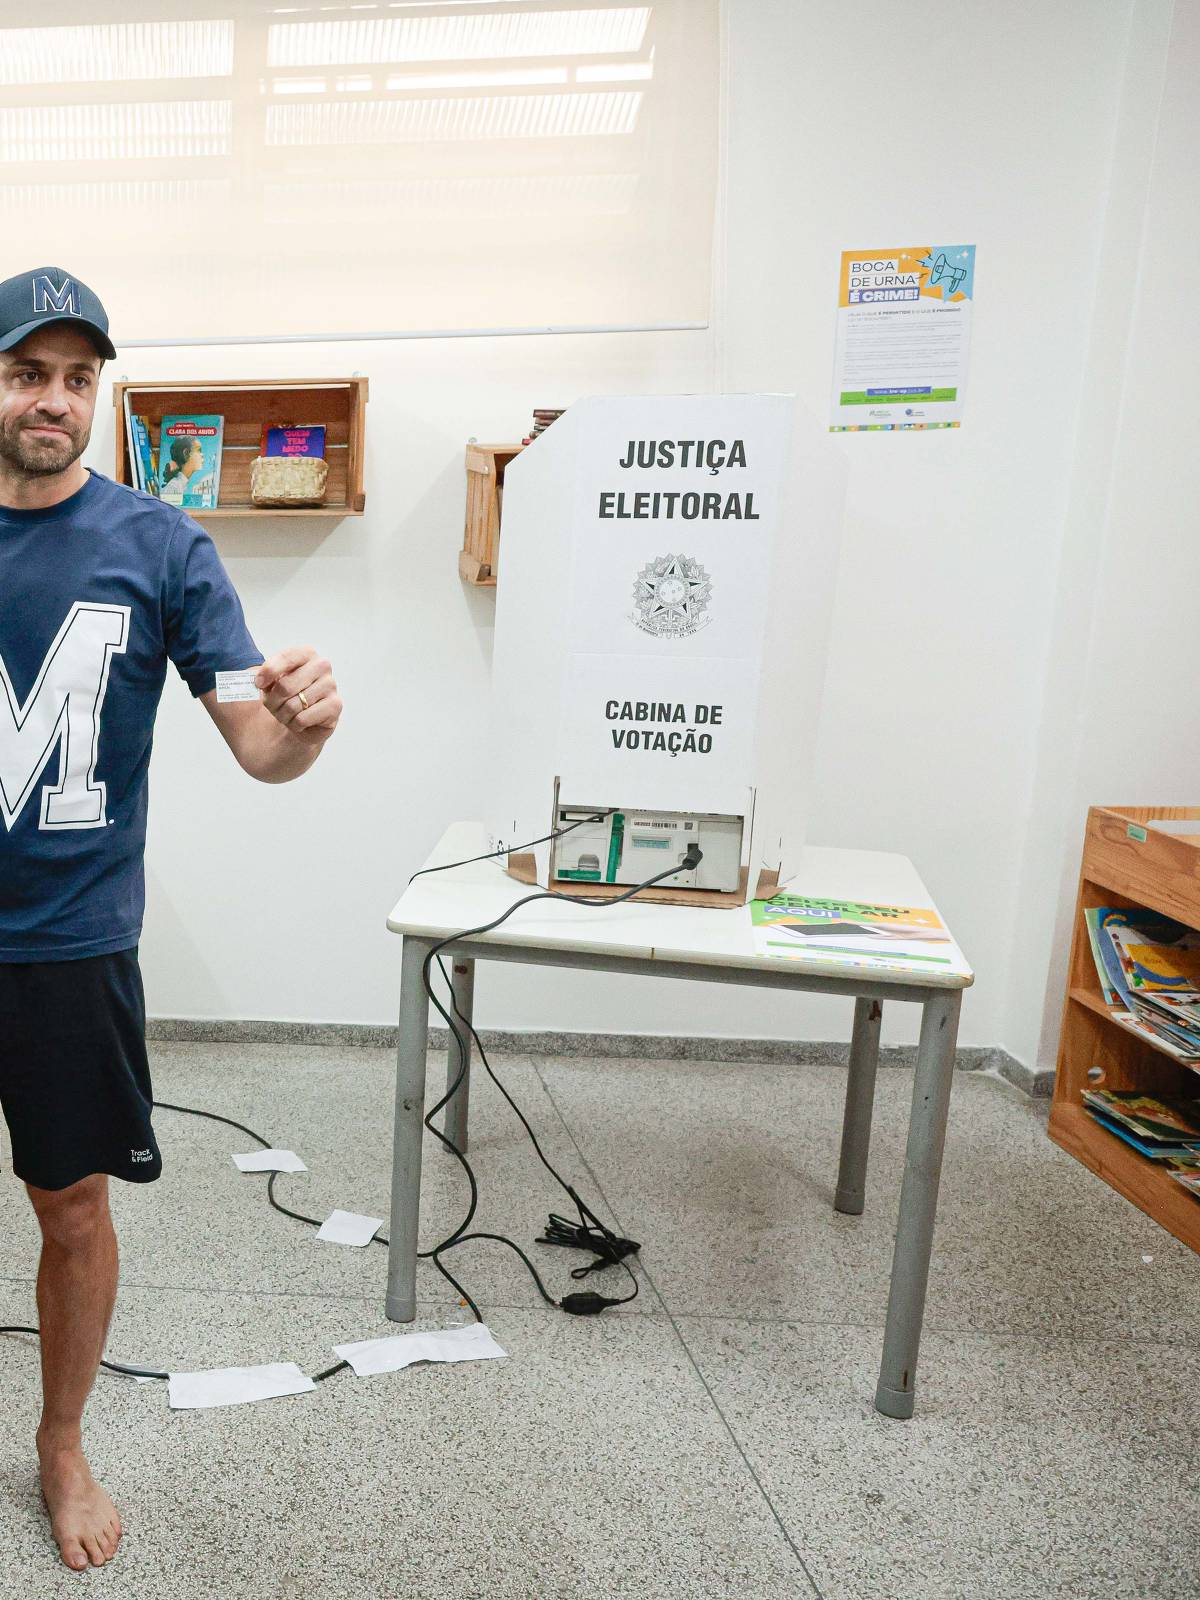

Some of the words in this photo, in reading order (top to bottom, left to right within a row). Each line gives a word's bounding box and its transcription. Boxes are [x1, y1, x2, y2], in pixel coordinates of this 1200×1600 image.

[851, 261, 895, 273] BOCA
[851, 277, 870, 288] DE
[874, 275, 916, 287] URNA
[32, 275, 82, 317] M
[850, 290, 859, 303] É
[861, 289, 919, 302] CRIME!
[287, 437, 306, 445] TEM
[282, 445, 309, 453] MEDO
[619, 439, 747, 475] JUSTIÇA
[598, 492, 760, 520] ELEITORAL
[605, 700, 686, 723] CABINA
[695, 704, 722, 725] DE
[611, 728, 713, 757] VOTAÇÃO
[767, 900, 899, 919] CELULAR
[767, 907, 833, 918] AQUI
[855, 904, 911, 914] SEU
[137, 1154, 153, 1163] Field
